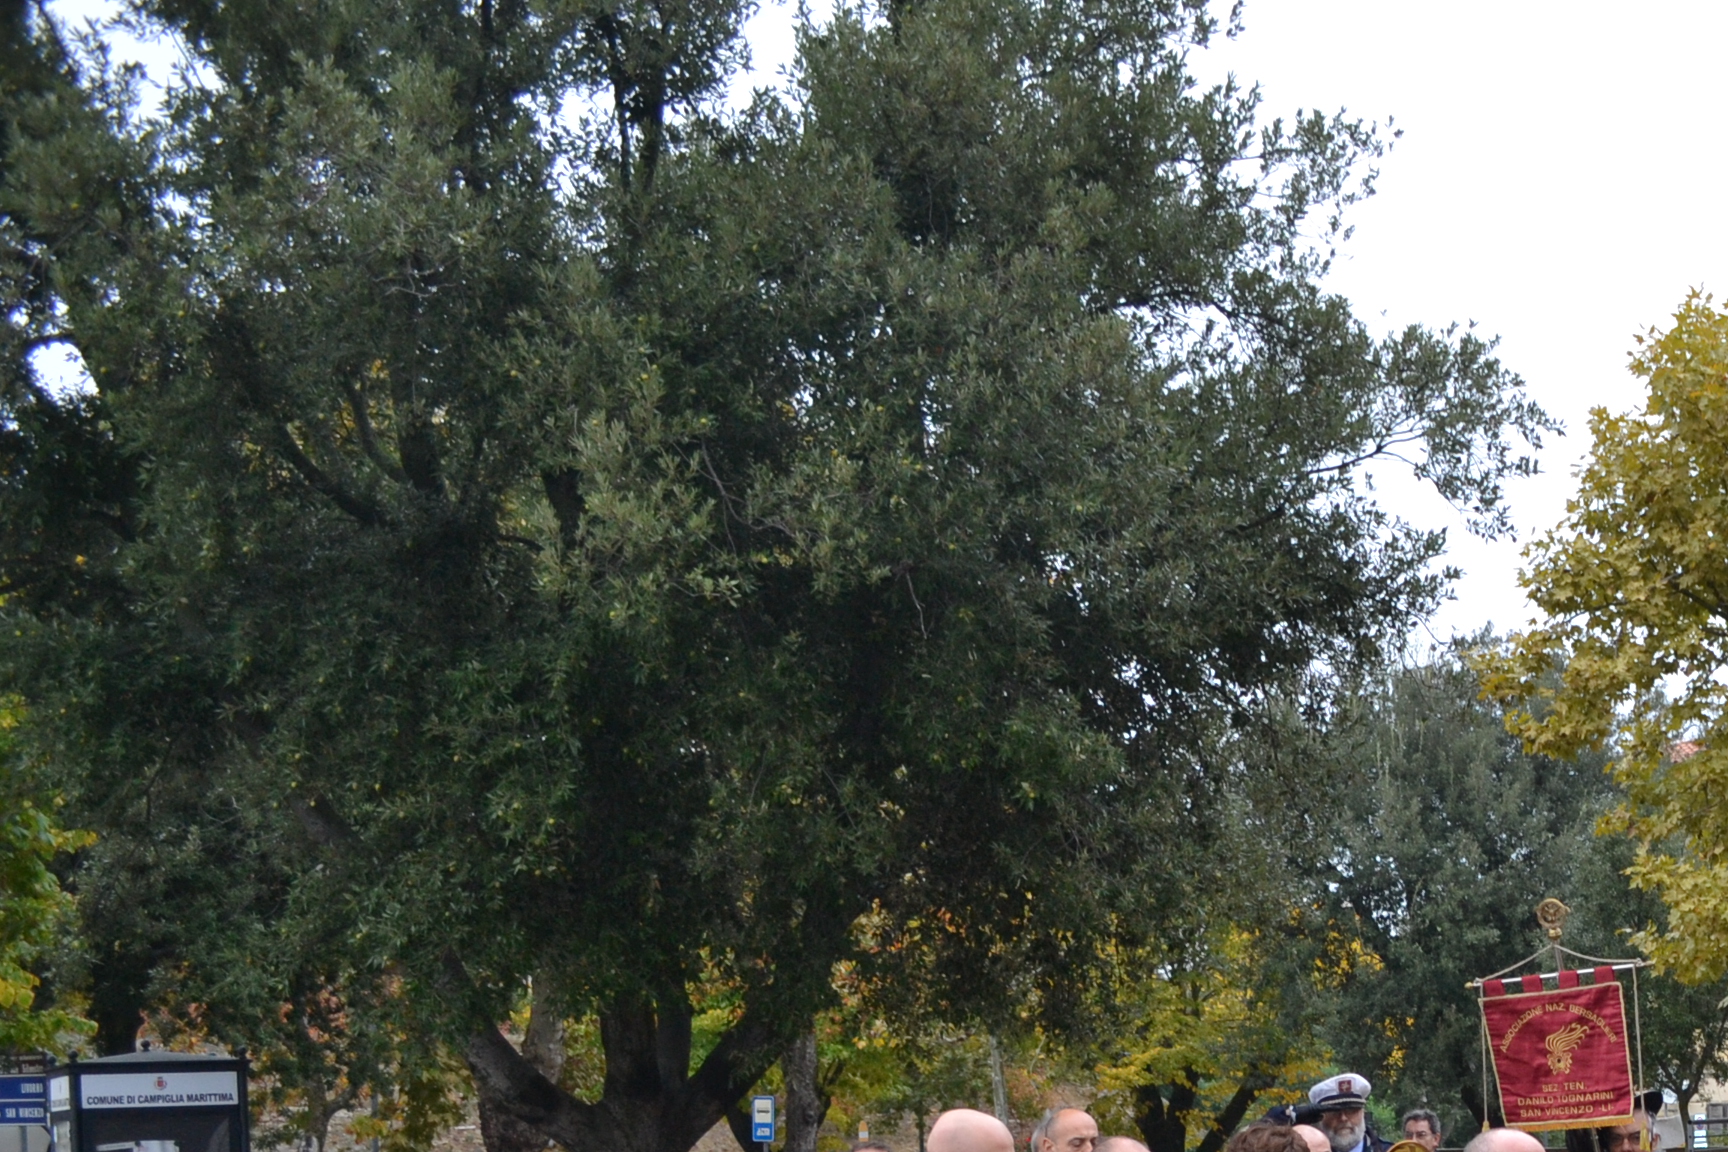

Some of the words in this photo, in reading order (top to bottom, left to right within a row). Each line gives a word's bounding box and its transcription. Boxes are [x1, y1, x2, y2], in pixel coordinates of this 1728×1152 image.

[1500, 1006, 1543, 1053] ASSOCIAZIONE
[1569, 1004, 1617, 1043] BERSAGLIERI
[87, 1095, 125, 1106] COMUNE
[126, 1095, 136, 1105] DI
[138, 1093, 185, 1104] CAMPIGLIA
[186, 1092, 234, 1103] MARITTIMA
[1517, 1096, 1554, 1106] DANILO
[1520, 1108, 1541, 1118] SAN
[1545, 1105, 1594, 1116] VINCENZO
